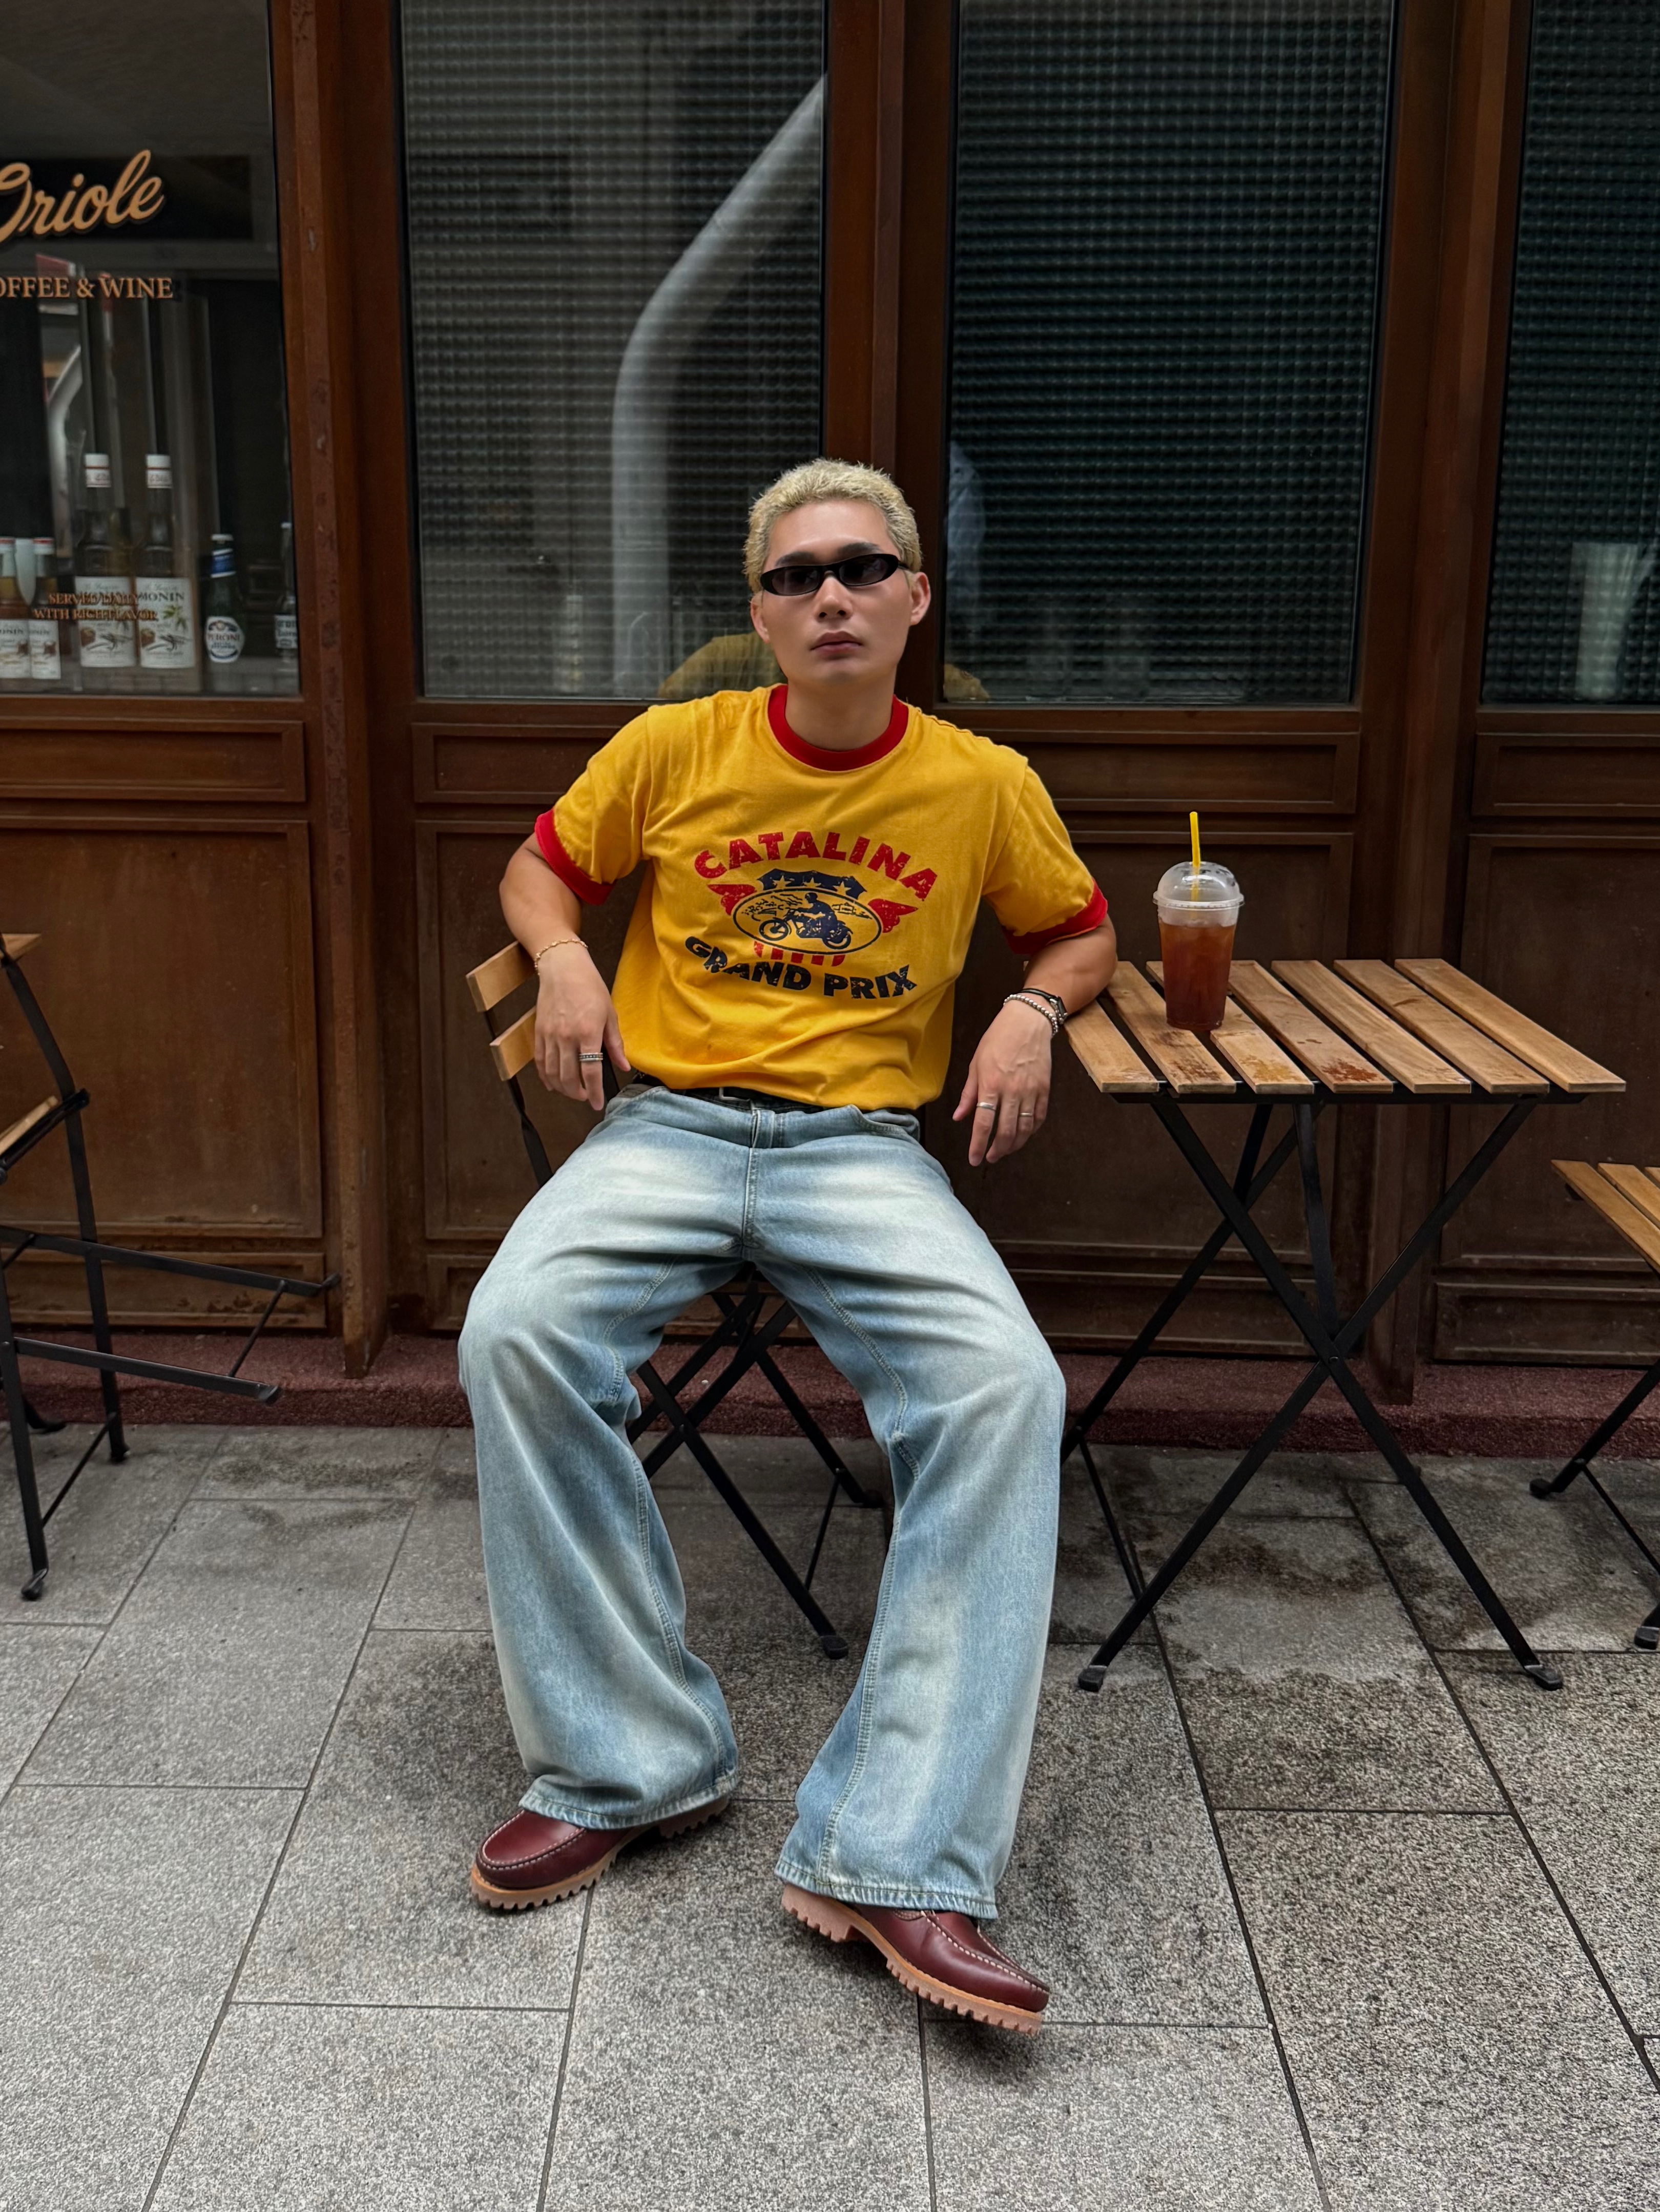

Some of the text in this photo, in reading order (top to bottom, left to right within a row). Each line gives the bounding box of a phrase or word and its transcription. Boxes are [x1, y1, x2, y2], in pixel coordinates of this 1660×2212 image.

[76, 277, 95, 299] &
[98, 277, 174, 299] WINE
[138, 592, 184, 601] MONIN
[32, 608, 70, 620] WITH
[694, 831, 938, 902] CATALINA
[684, 935, 918, 1000] GRAND PRIX
